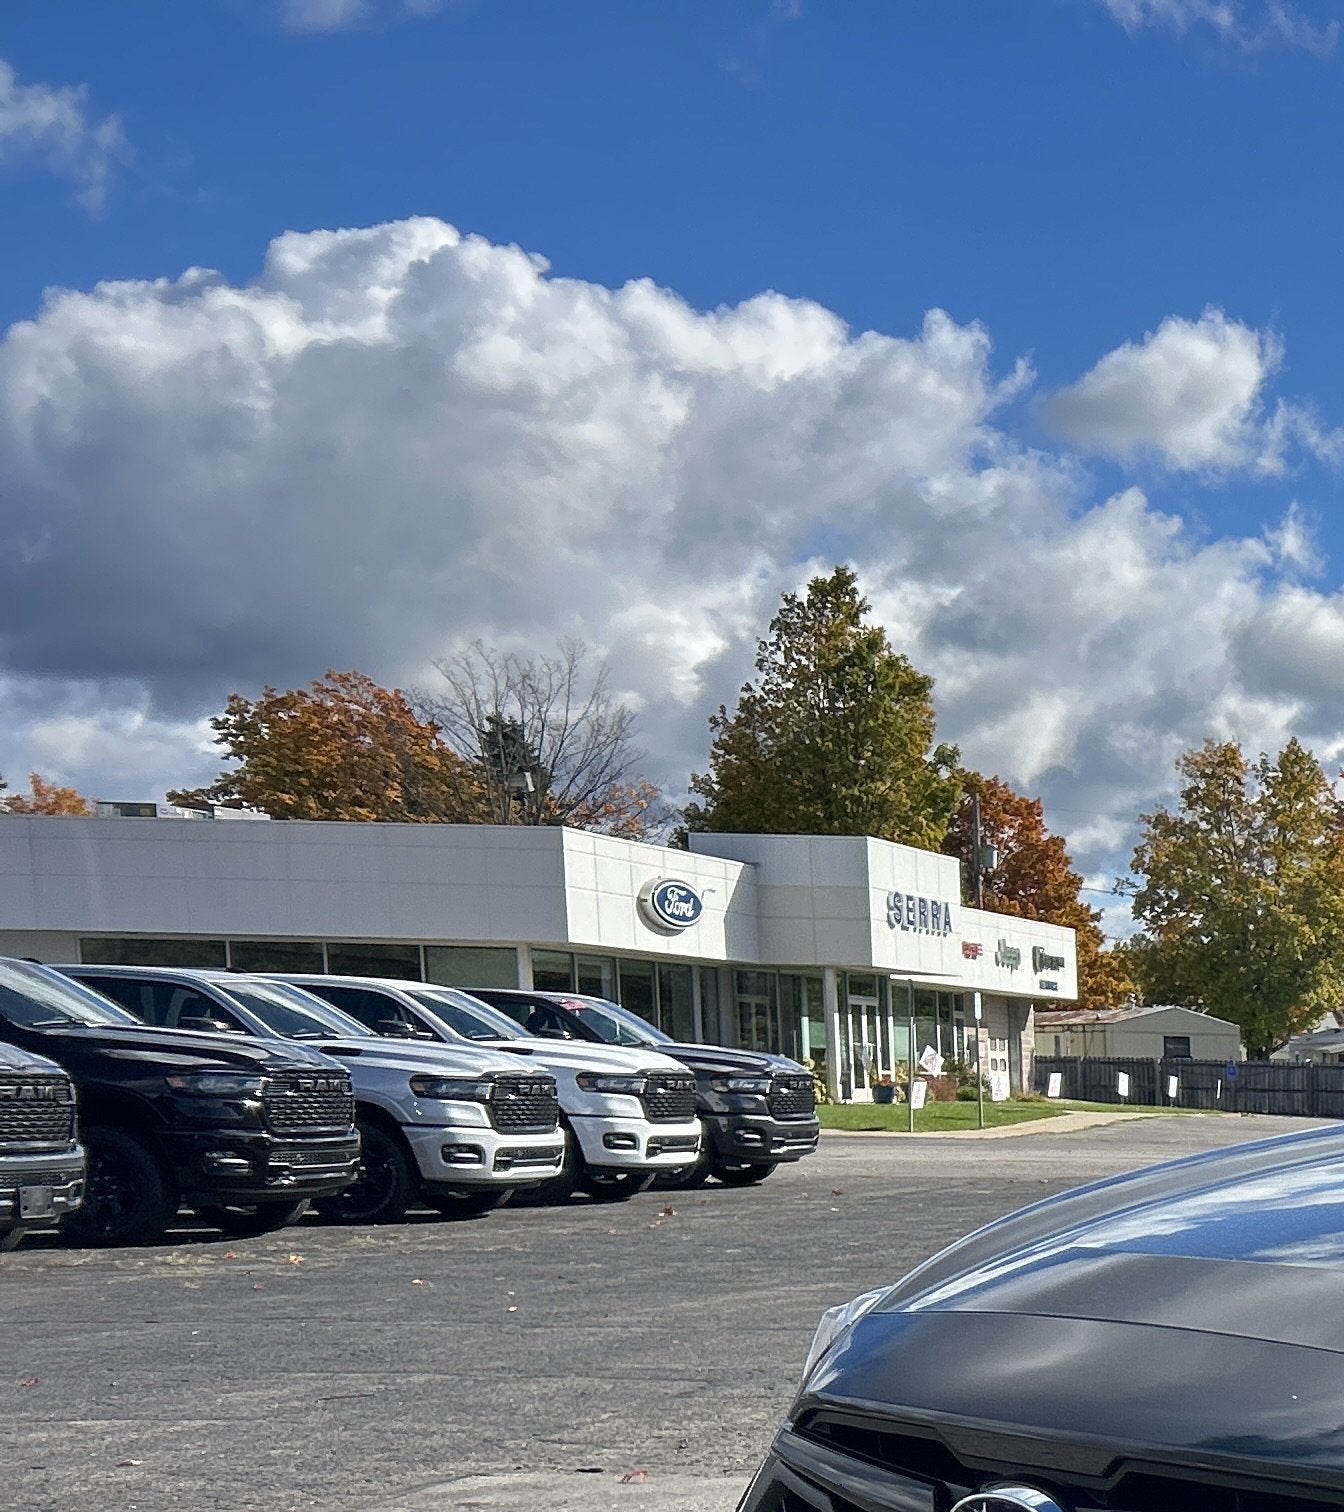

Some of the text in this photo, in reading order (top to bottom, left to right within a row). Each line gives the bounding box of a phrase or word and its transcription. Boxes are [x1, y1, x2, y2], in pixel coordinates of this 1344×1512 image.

[664, 886, 695, 918] Ford
[888, 891, 953, 934] SERRA
[298, 1079, 340, 1091] RAM
